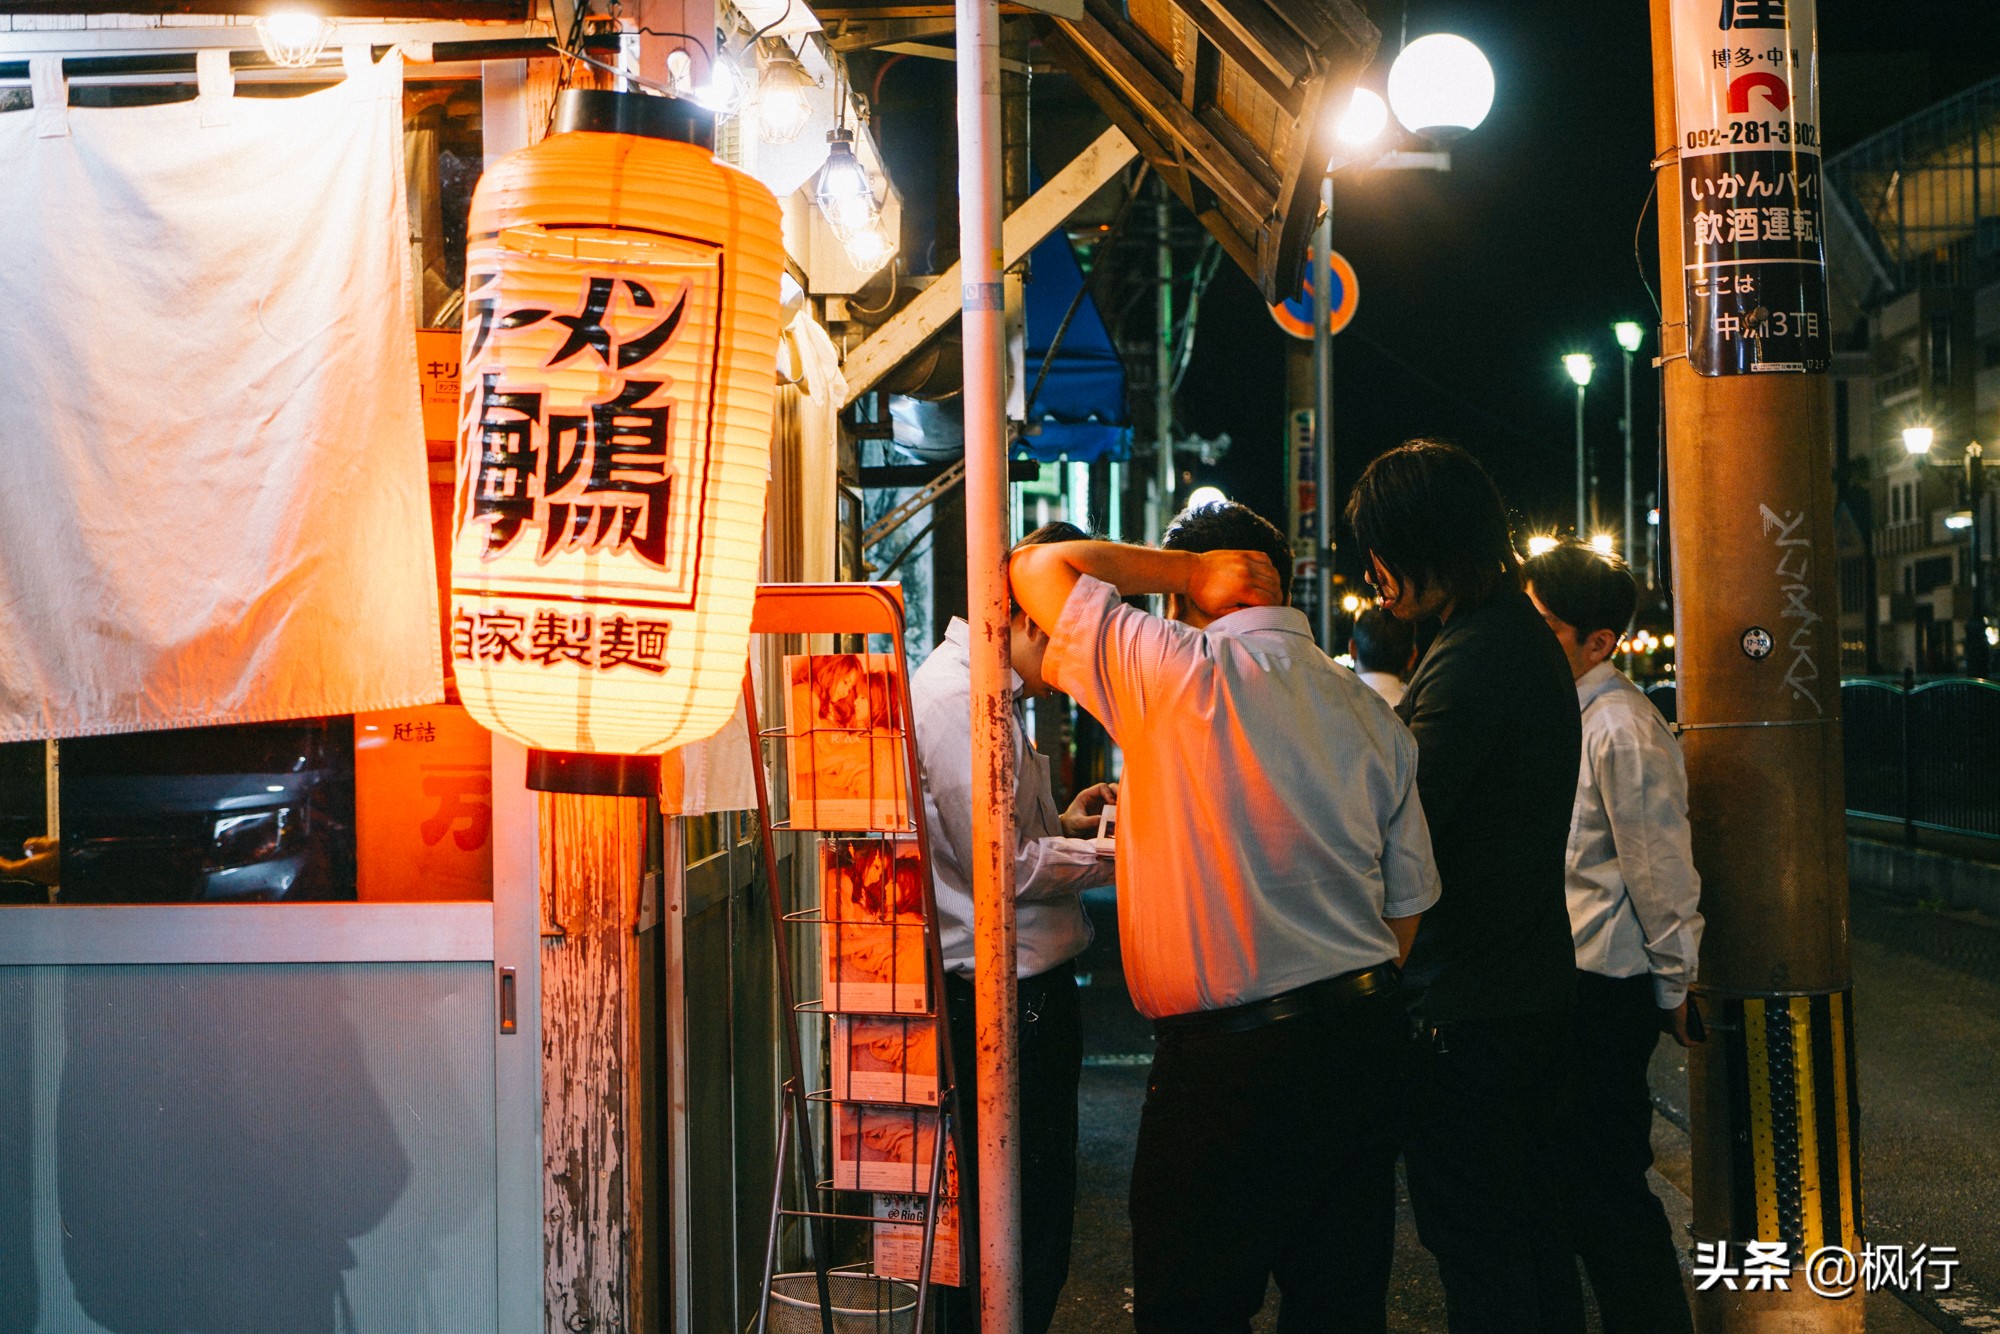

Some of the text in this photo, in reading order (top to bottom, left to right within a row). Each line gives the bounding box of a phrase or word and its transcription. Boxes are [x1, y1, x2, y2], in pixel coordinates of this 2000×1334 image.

[1695, 274, 1755, 297] ここは
[464, 273, 688, 371] ラーメン
[454, 607, 671, 673] 自家製麺
